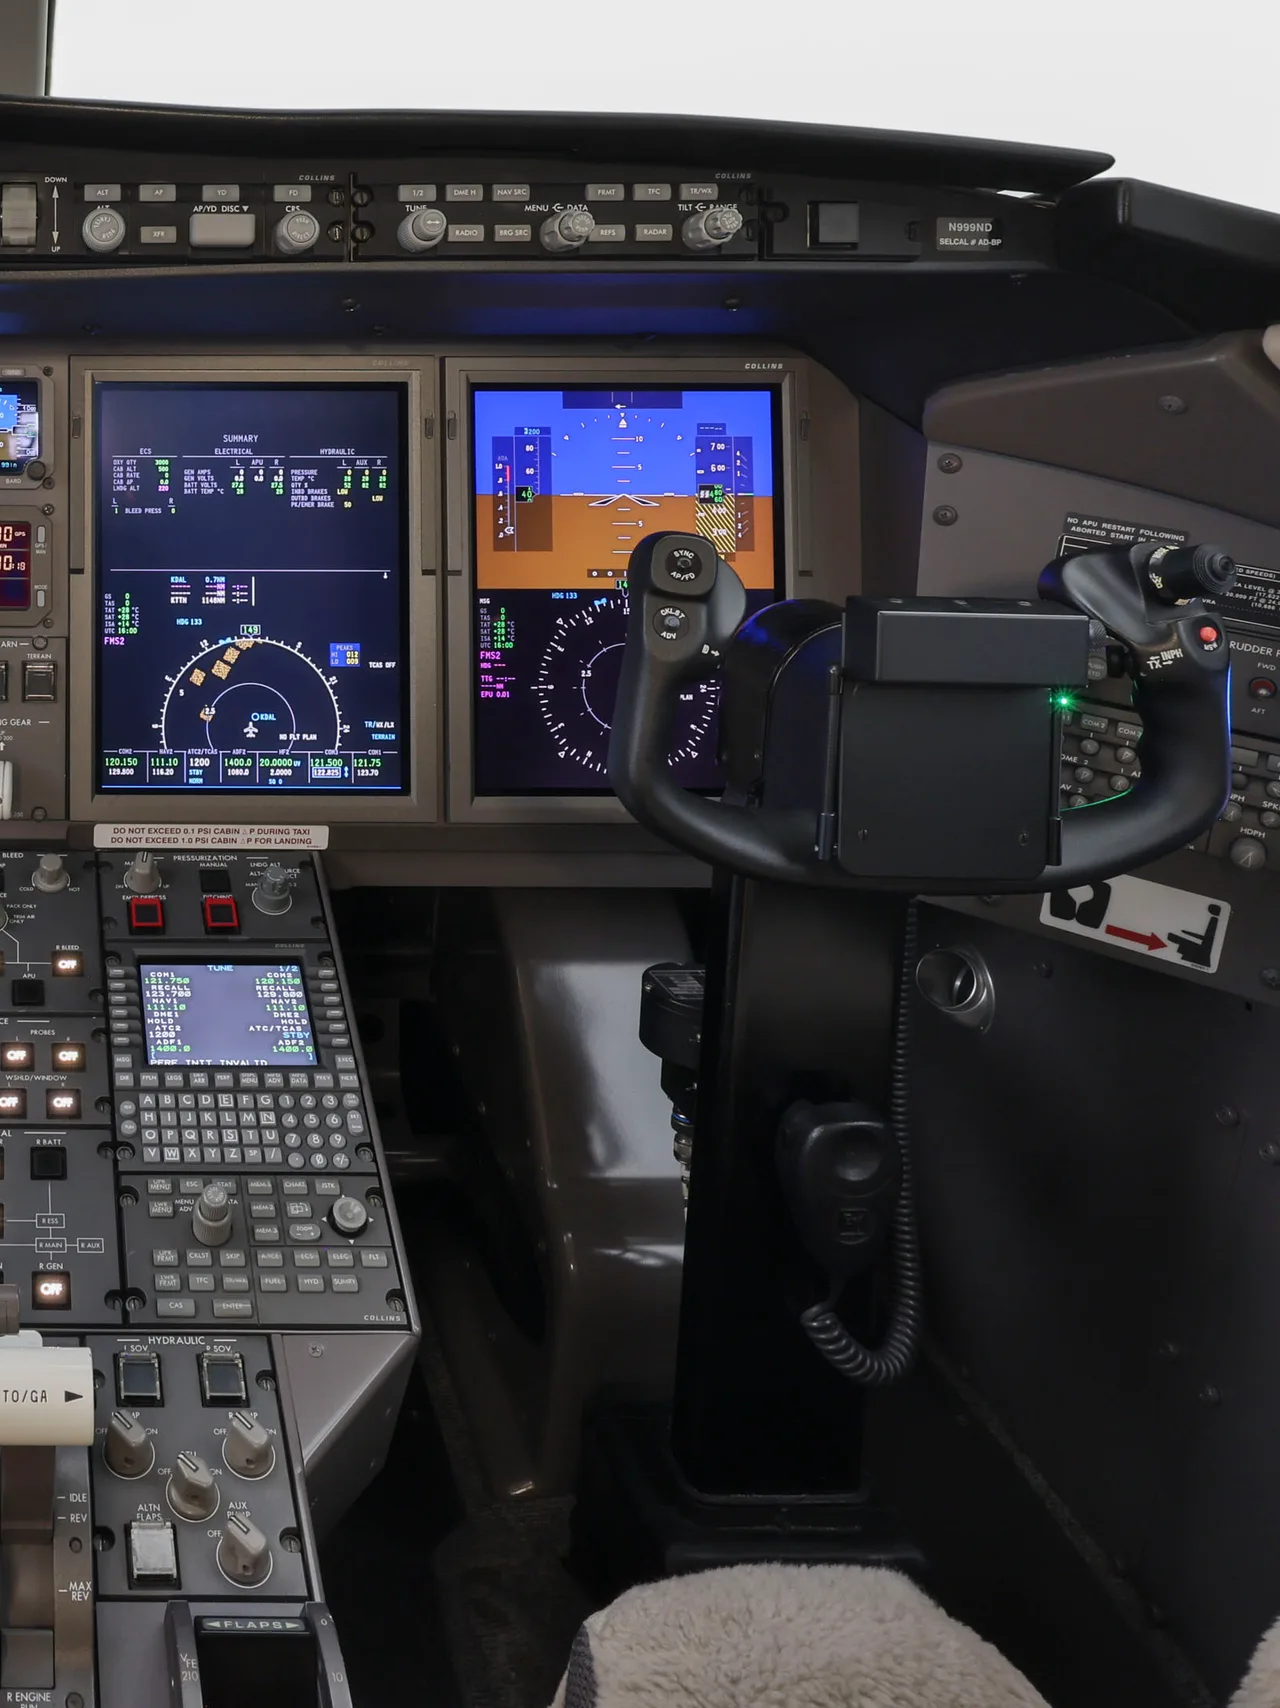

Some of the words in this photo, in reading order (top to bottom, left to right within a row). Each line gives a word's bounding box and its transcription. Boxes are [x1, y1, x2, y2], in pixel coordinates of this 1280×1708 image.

[193, 205, 217, 213] AP/YD
[221, 205, 240, 213] DISC
[524, 204, 549, 212] MENU
[948, 222, 992, 232] N999ND
[939, 238, 969, 246] SELCAL
[223, 434, 258, 443] SUMMARY
[1071, 525, 1107, 536] ABORTED
[1110, 532, 1134, 541] START
[1082, 519, 1098, 528] APU
[1101, 522, 1136, 534] RESTART
[1139, 528, 1185, 542] FOLLOWING
[104, 637, 125, 645] FMS2
[1229, 640, 1273, 656] RUDDER
[480, 651, 501, 660] FMS2
[1161, 649, 1183, 661] INPH
[105, 758, 138, 767] 120.150
[151, 758, 178, 767] 111.10
[189, 758, 210, 767] 1200
[259, 758, 293, 767] 20.0000
[310, 758, 343, 767] 121.500
[353, 758, 381, 767] 121.75
[40, 1283, 63, 1295] OFF
[149, 1336, 205, 1345] HYDRAULIC
[3, 1390, 48, 1404] TO/GA
[69, 1492, 87, 1502] IDLE
[138, 1503, 160, 1512] ALTN
[229, 1501, 247, 1510] AUX
[69, 1581, 92, 1591] MAX
[72, 1591, 89, 1601] REV
[223, 1620, 282, 1629] FLAPS
[182, 1670, 198, 1681] 210
[7, 1692, 12, 1702] R
[16, 1692, 51, 1702] ENGINE
